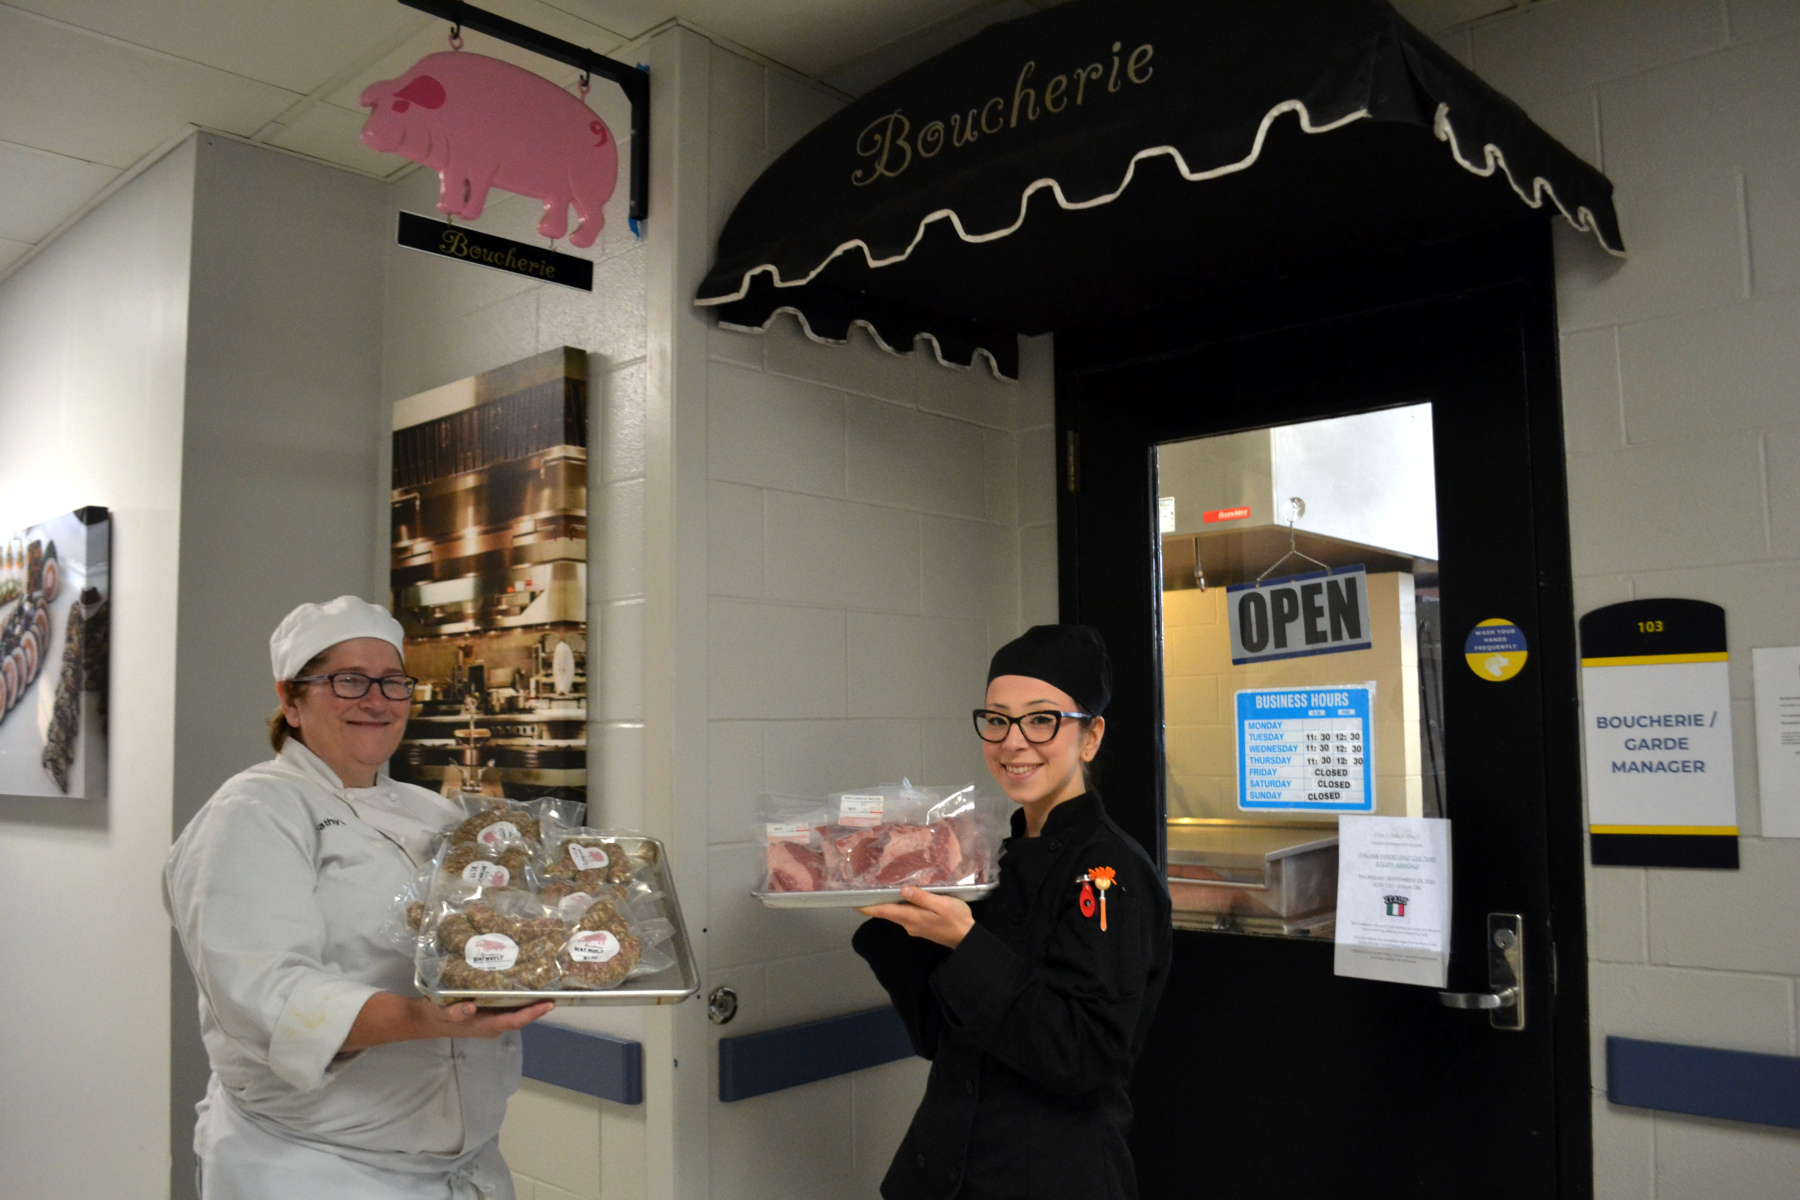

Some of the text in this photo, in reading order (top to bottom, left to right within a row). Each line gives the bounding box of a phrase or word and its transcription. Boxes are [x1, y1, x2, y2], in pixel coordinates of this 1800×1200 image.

[851, 41, 1154, 186] Boucherie
[439, 230, 556, 278] Boucherie
[1238, 577, 1362, 653] OPEN
[1638, 620, 1664, 633] 103
[1255, 692, 1349, 709] BUSINESS HOURS
[1248, 721, 1283, 730] MONDAY
[1596, 711, 1717, 729] BOUCHERIE /
[1249, 733, 1284, 741] TUESDAY
[1249, 744, 1298, 753] WEDNESDAY
[1624, 737, 1689, 751] GARDE
[1249, 756, 1292, 764] THURSDAY
[1611, 760, 1706, 773] MANAGER
[1249, 768, 1348, 777] FRIDAY CLOSED
[1250, 780, 1351, 789] SATURDAY CLOSED
[1250, 791, 1340, 801] SUNDAY CLOSED
